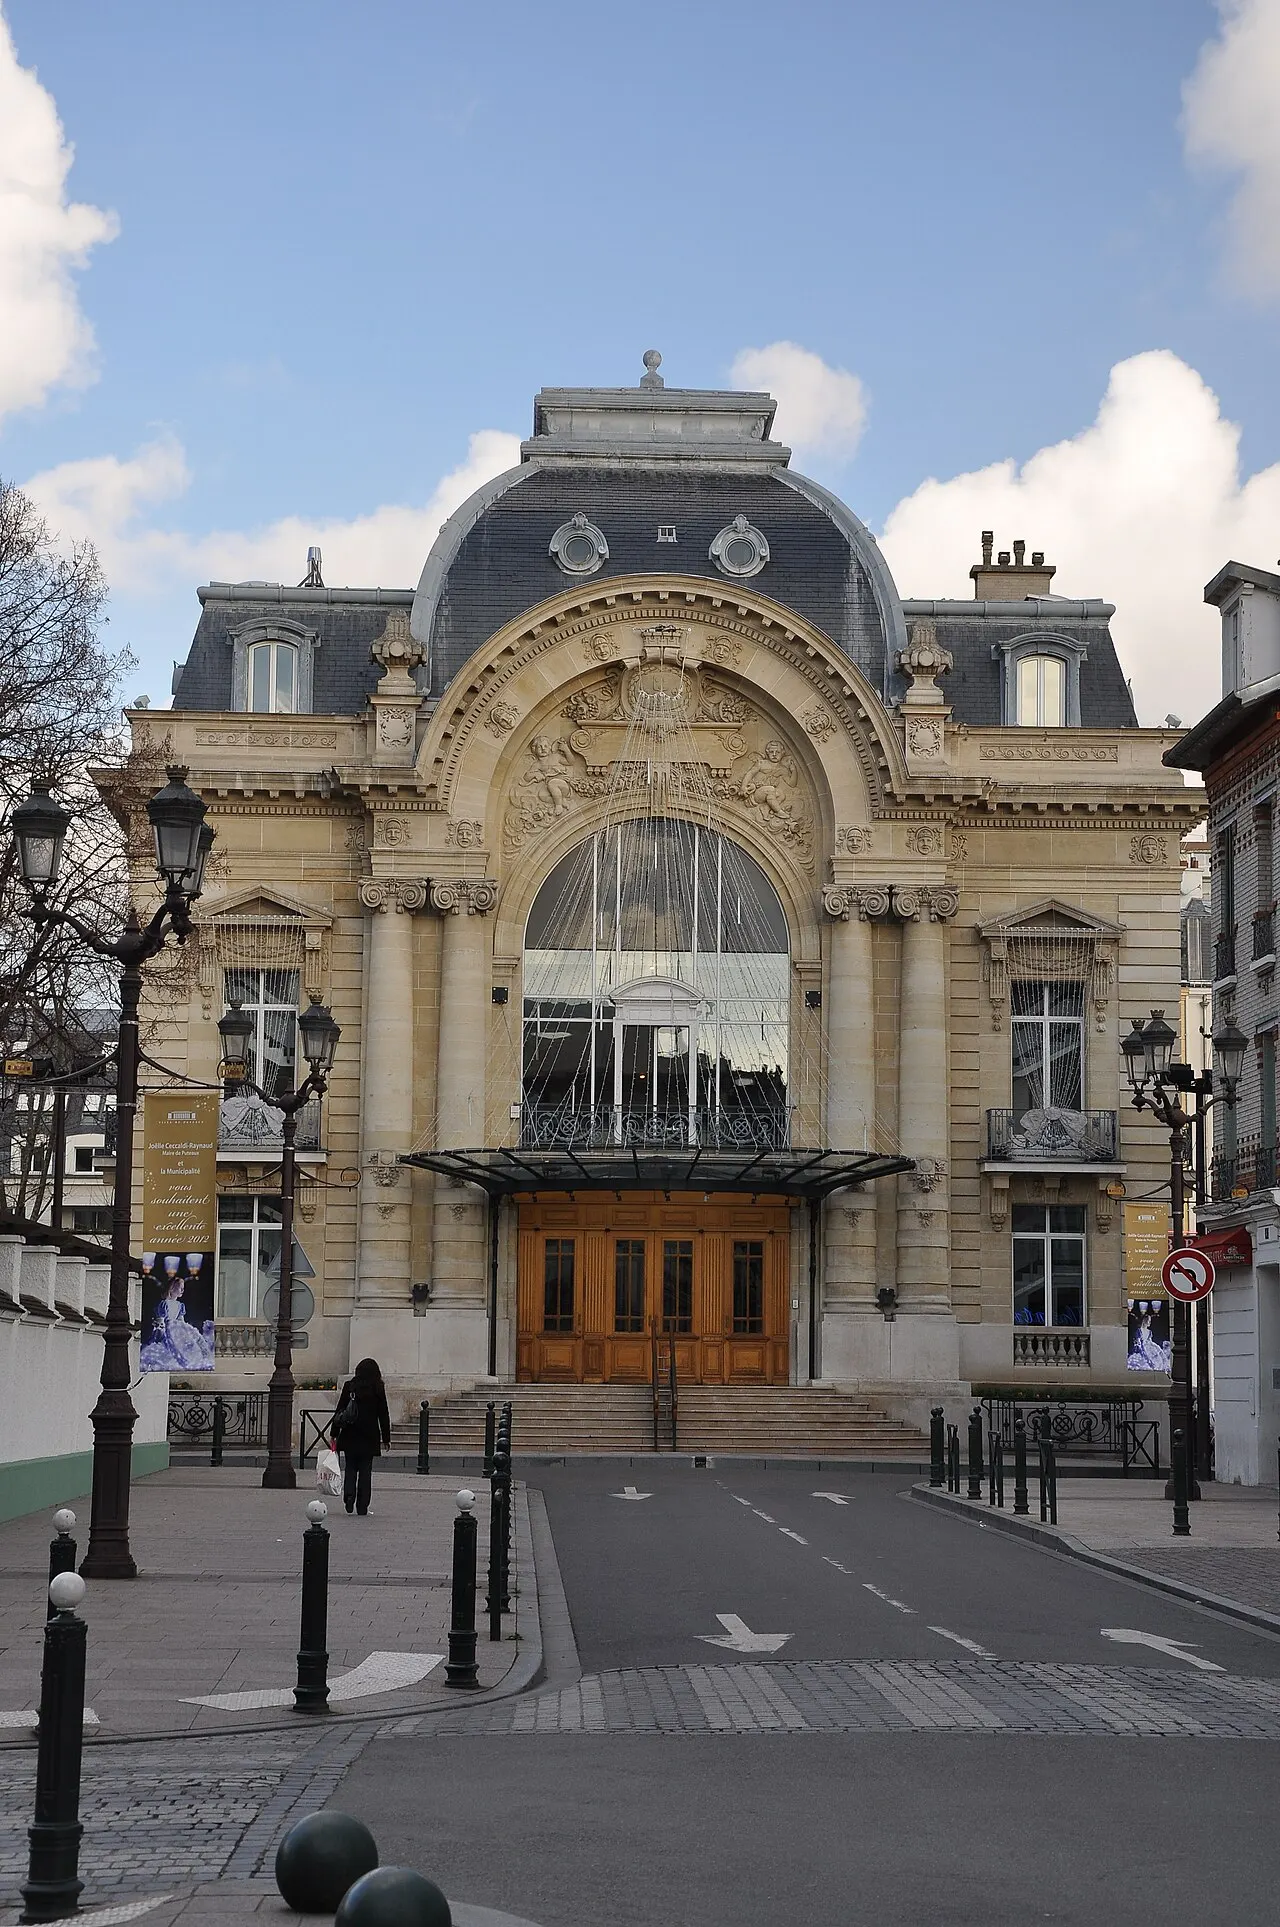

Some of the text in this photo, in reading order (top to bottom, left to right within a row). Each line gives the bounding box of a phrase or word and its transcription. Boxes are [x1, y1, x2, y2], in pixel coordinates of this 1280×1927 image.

[165, 1142, 213, 1150] Ceccaldi-Raynaud
[150, 1192, 210, 1205] souhaitent
[153, 1215, 208, 1231] excellente
[149, 1234, 210, 1243] année 2012
